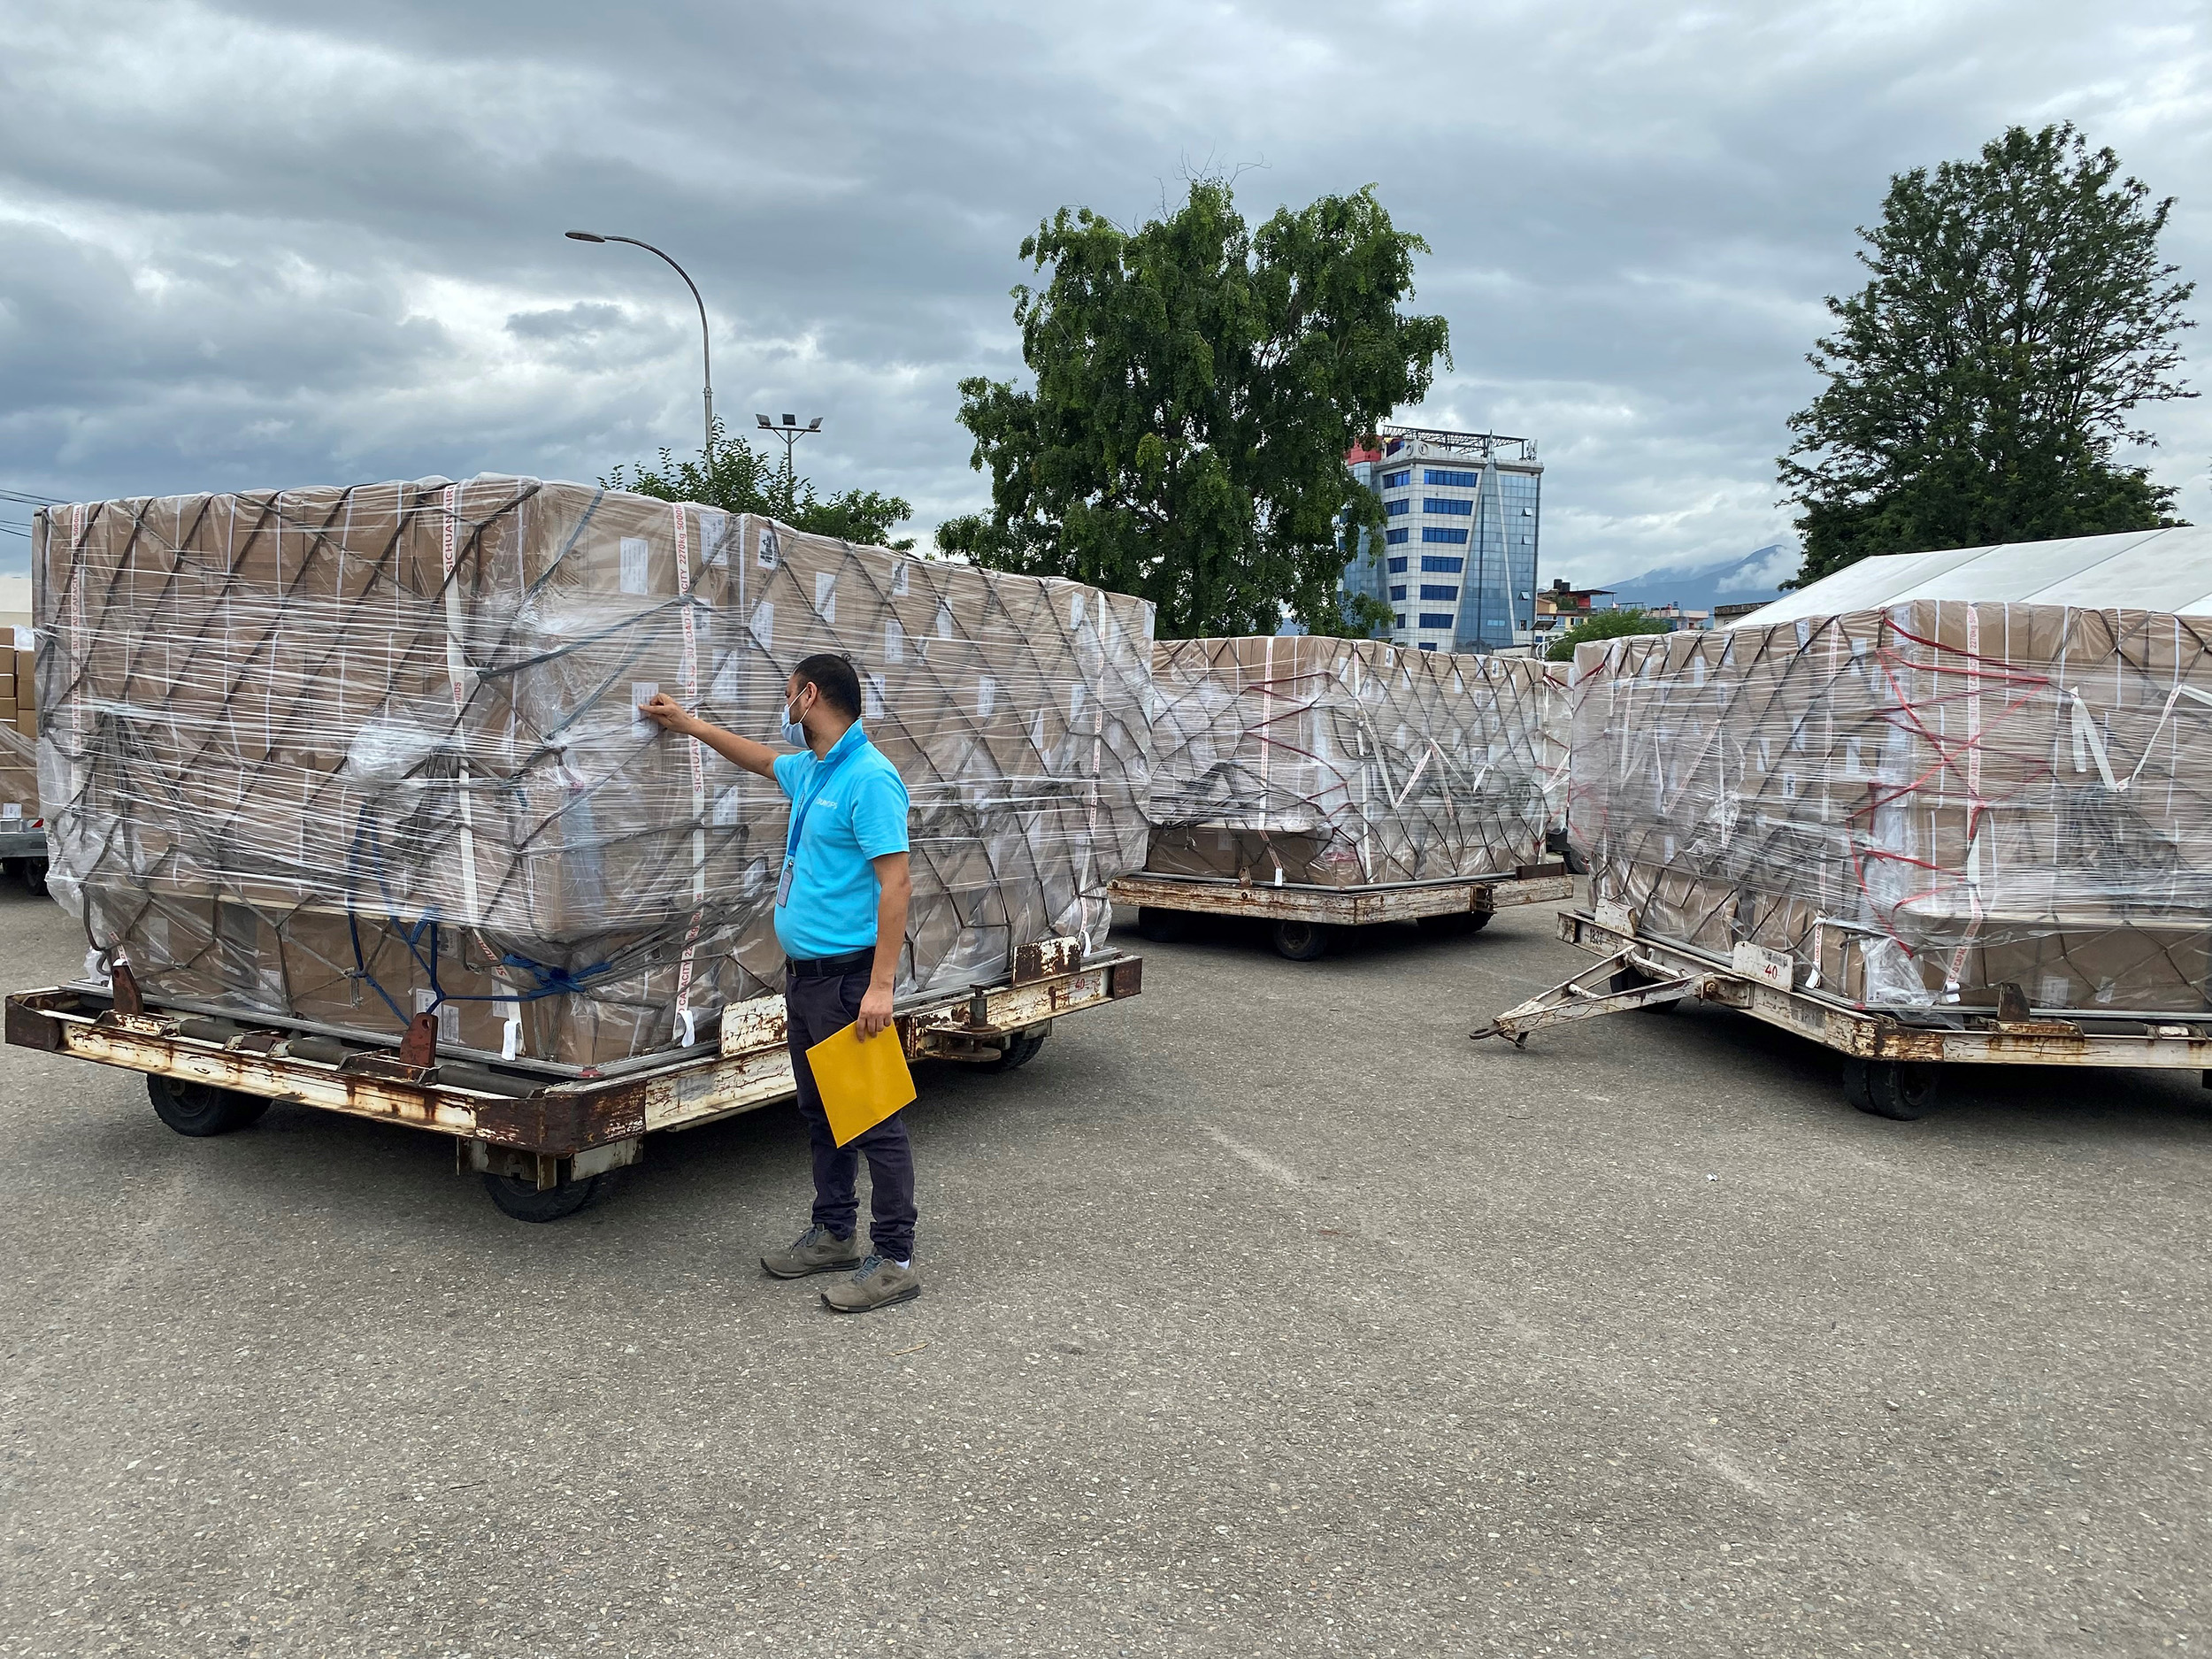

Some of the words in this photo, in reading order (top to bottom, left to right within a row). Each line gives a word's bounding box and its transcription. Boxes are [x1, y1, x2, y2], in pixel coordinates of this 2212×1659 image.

[678, 534, 687, 565] 2270kg
[1969, 625, 1978, 649] 2270kg
[691, 739, 702, 792] SICHUAN
[1764, 964, 1778, 979] 40
[1075, 978, 1086, 990] 40
